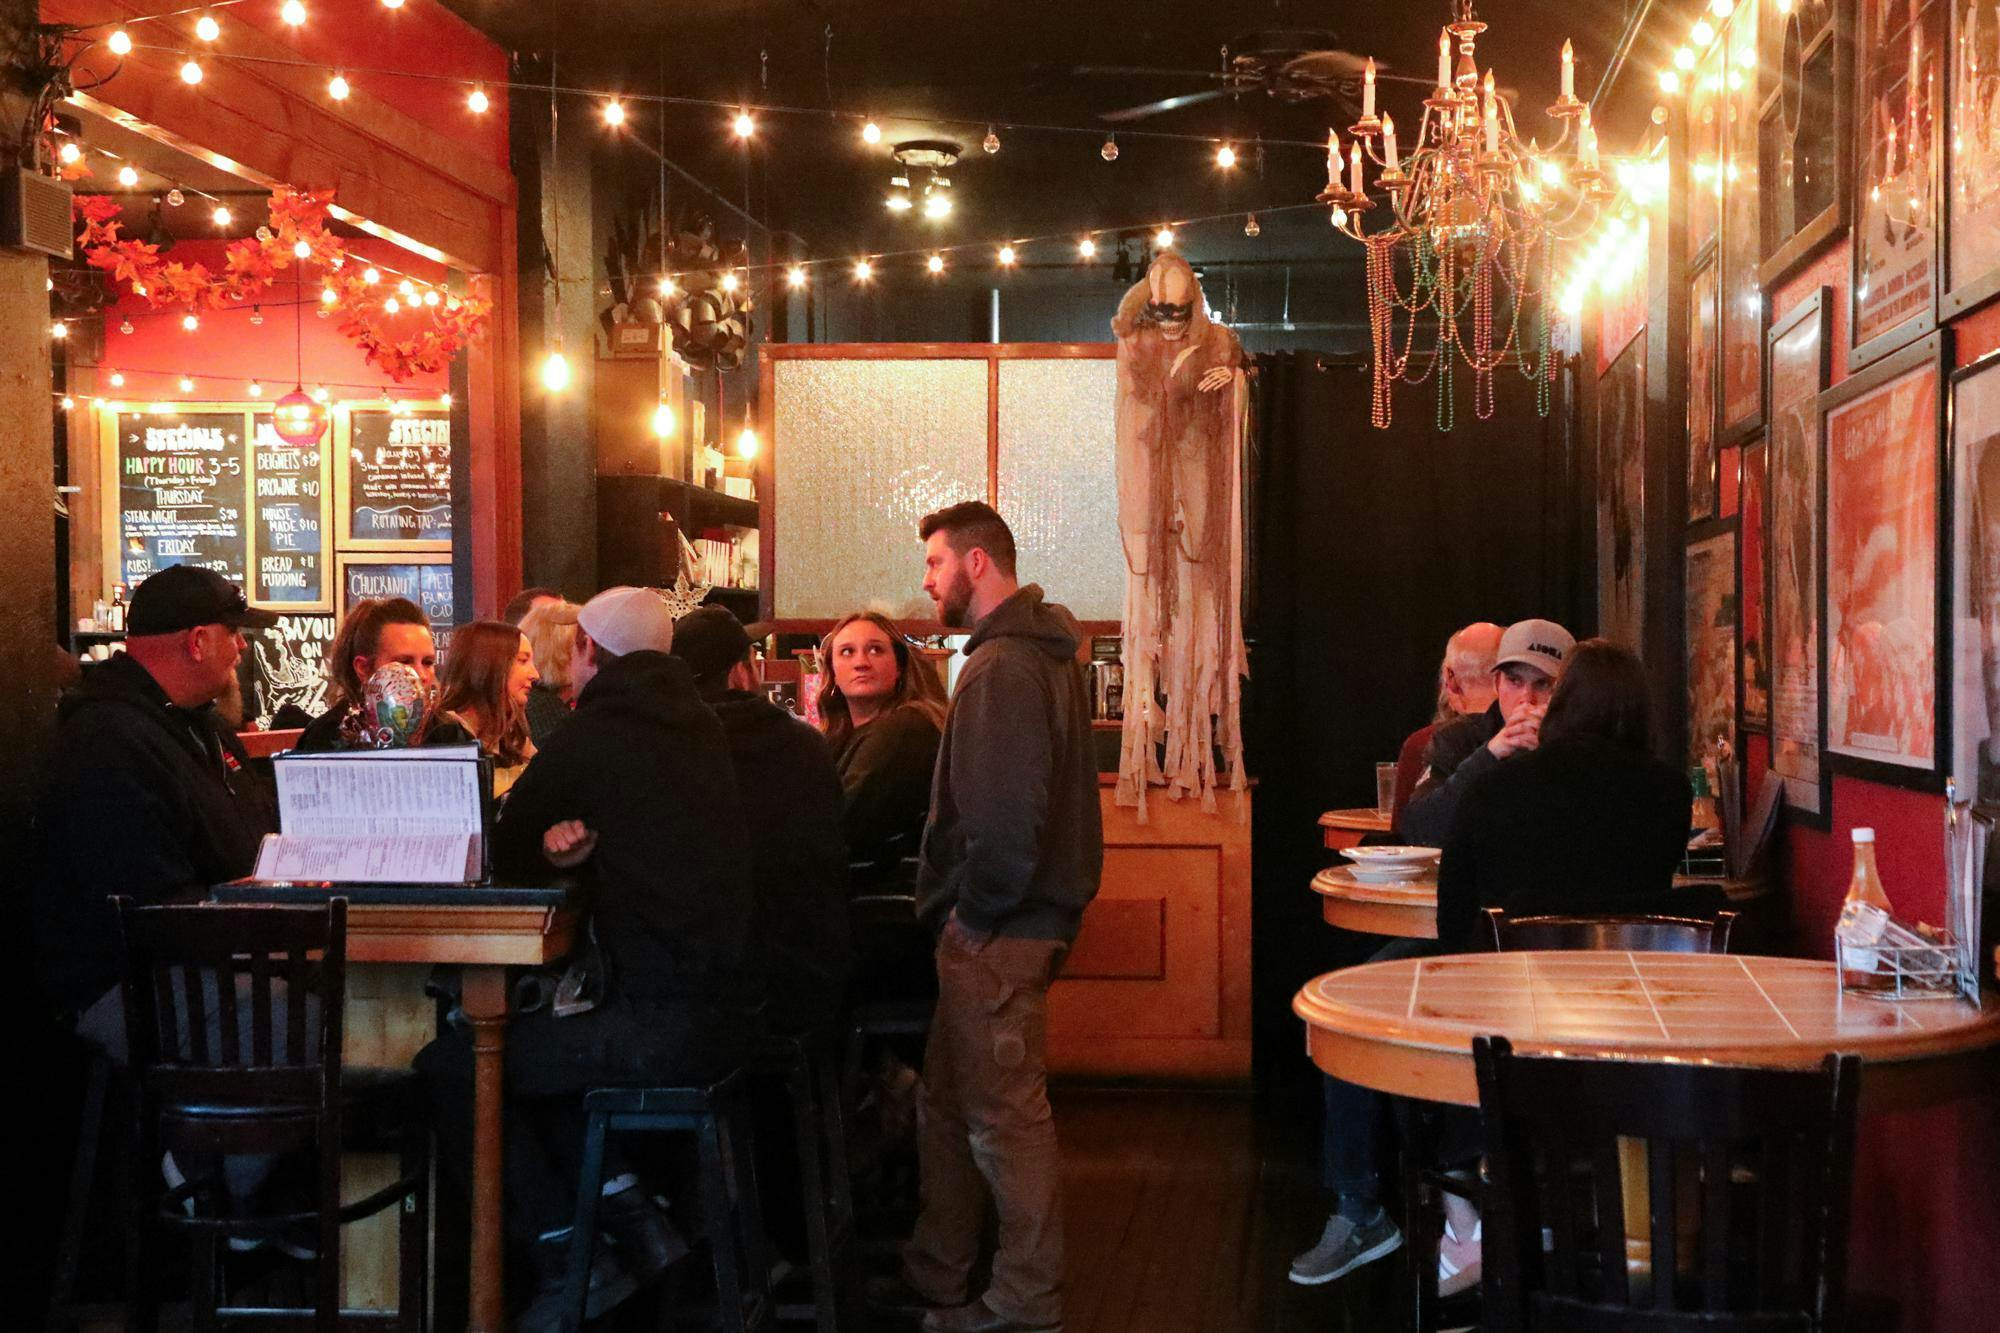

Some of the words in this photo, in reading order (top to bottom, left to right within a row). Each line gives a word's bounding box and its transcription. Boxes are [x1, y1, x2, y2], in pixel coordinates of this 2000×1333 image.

[145, 427, 225, 451] SPECIALS
[125, 457, 166, 474] HAPPY
[168, 457, 205, 474] HOUR
[208, 457, 240, 475] 3-5
[257, 452, 300, 470] BEIGNETS
[257, 478, 299, 496] BROWNIE
[302, 480, 320, 497] $10
[153, 488, 204, 505] THURSDAY
[124, 510, 150, 523] STEAK
[269, 520, 299, 532] MADE
[299, 518, 318, 531] $10
[371, 514, 416, 529] ROTATING
[157, 539, 196, 553] FRIDAY
[275, 532, 296, 546] PIE
[261, 555, 293, 572] BREAD
[261, 572, 307, 587] PUDDING
[351, 573, 413, 595] CHUCKANUT
[276, 616, 335, 641] BAYOU
[301, 642, 322, 659] ON
[305, 658, 333, 680] BA
